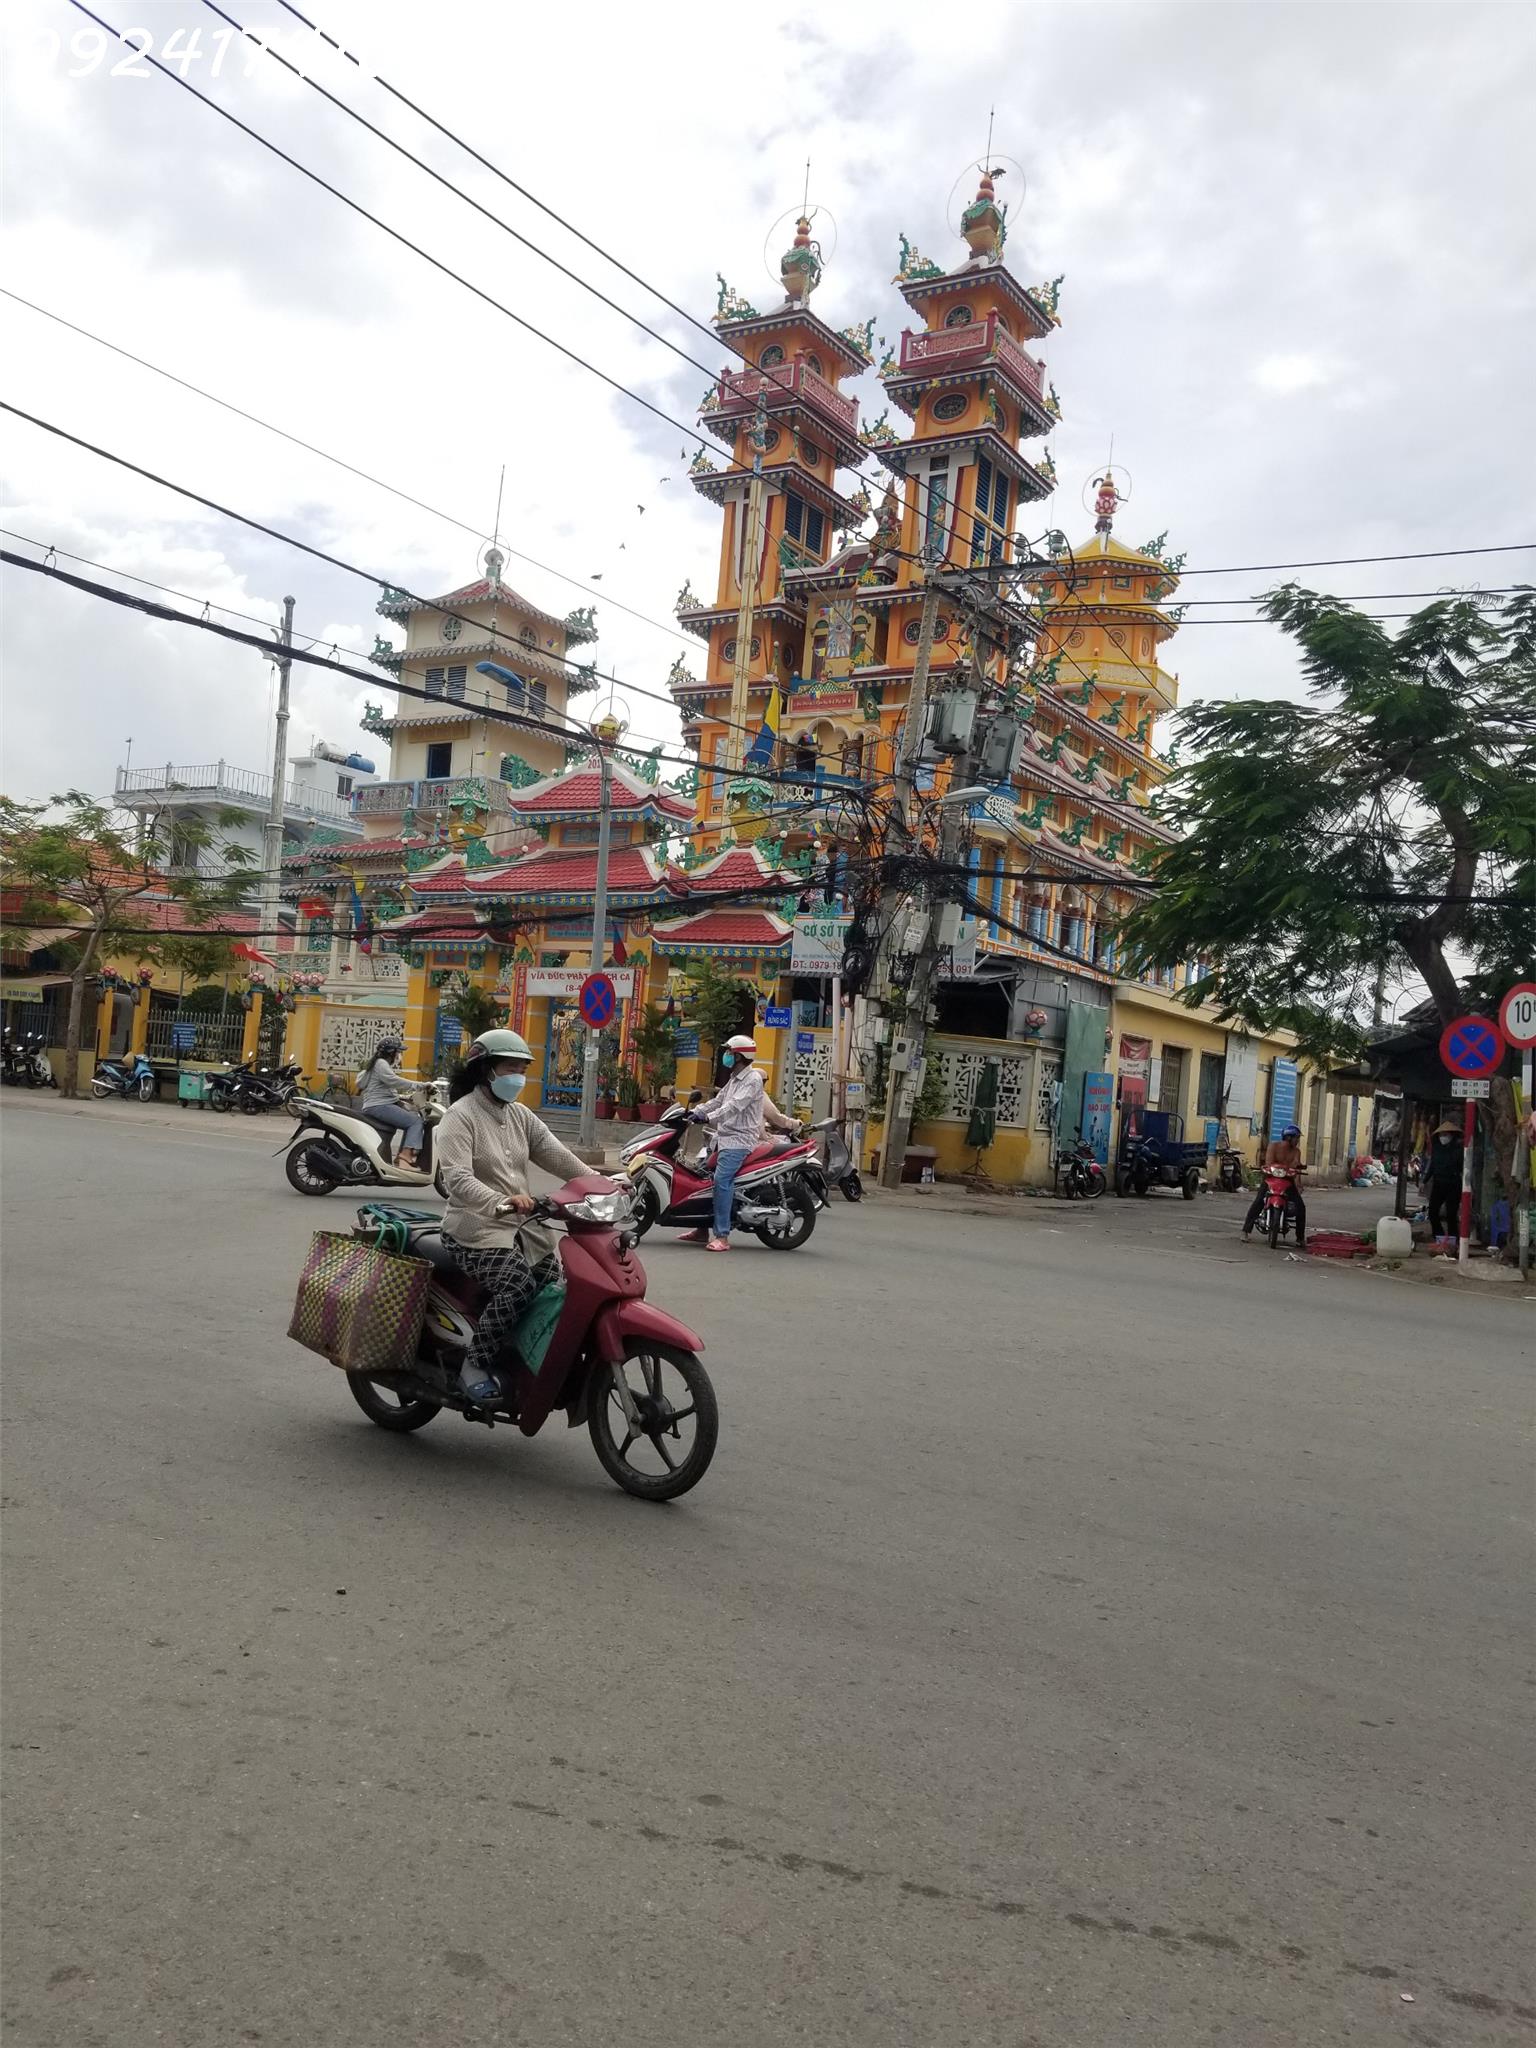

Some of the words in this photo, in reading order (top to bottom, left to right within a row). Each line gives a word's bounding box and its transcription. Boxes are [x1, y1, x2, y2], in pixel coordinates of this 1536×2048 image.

[587, 758, 607, 769] 201
[809, 961, 831, 970] 0979
[620, 973, 631, 981] CA
